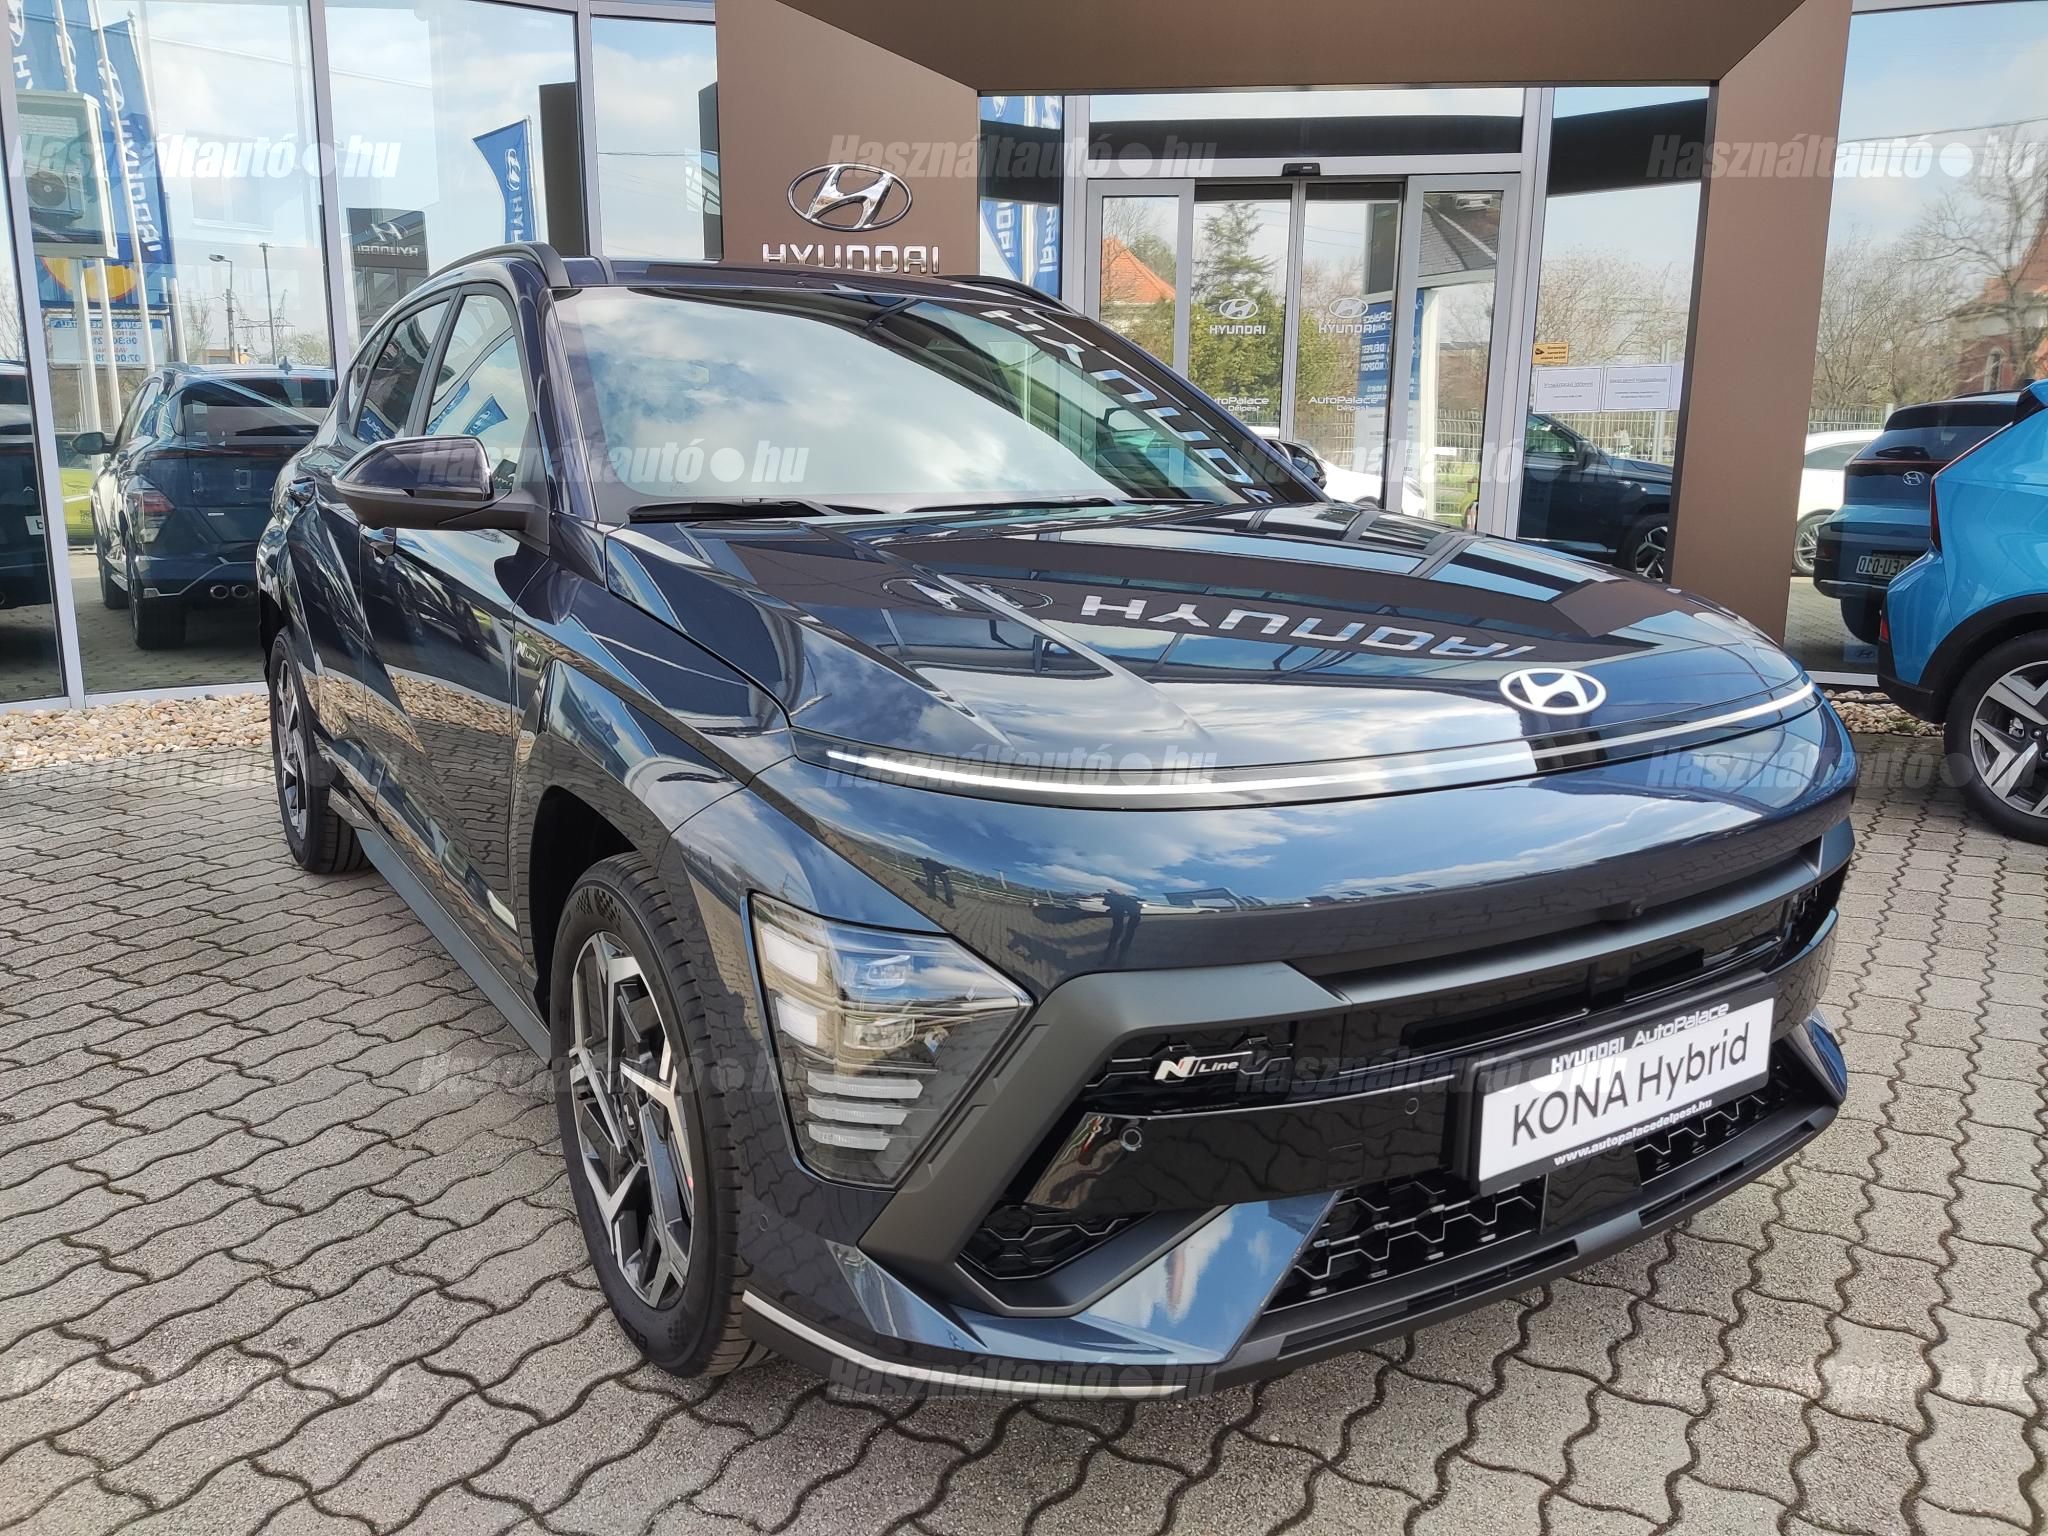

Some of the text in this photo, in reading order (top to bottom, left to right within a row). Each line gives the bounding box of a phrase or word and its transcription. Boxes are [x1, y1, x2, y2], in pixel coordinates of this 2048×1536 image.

[762, 243, 940, 274] HYUNDAI
[1209, 324, 1266, 335] HYUNDAI
[1318, 324, 1376, 334] HYUNDAI
[1213, 396, 1270, 405] utoPalace
[1551, 1003, 1730, 1075] HYUNDAI AutoPalace
[1199, 1061, 1239, 1073] Line
[1512, 1021, 1750, 1147] KONA Hybrid
[1553, 1099, 1713, 1166] www.autopalacedelpest.hu
